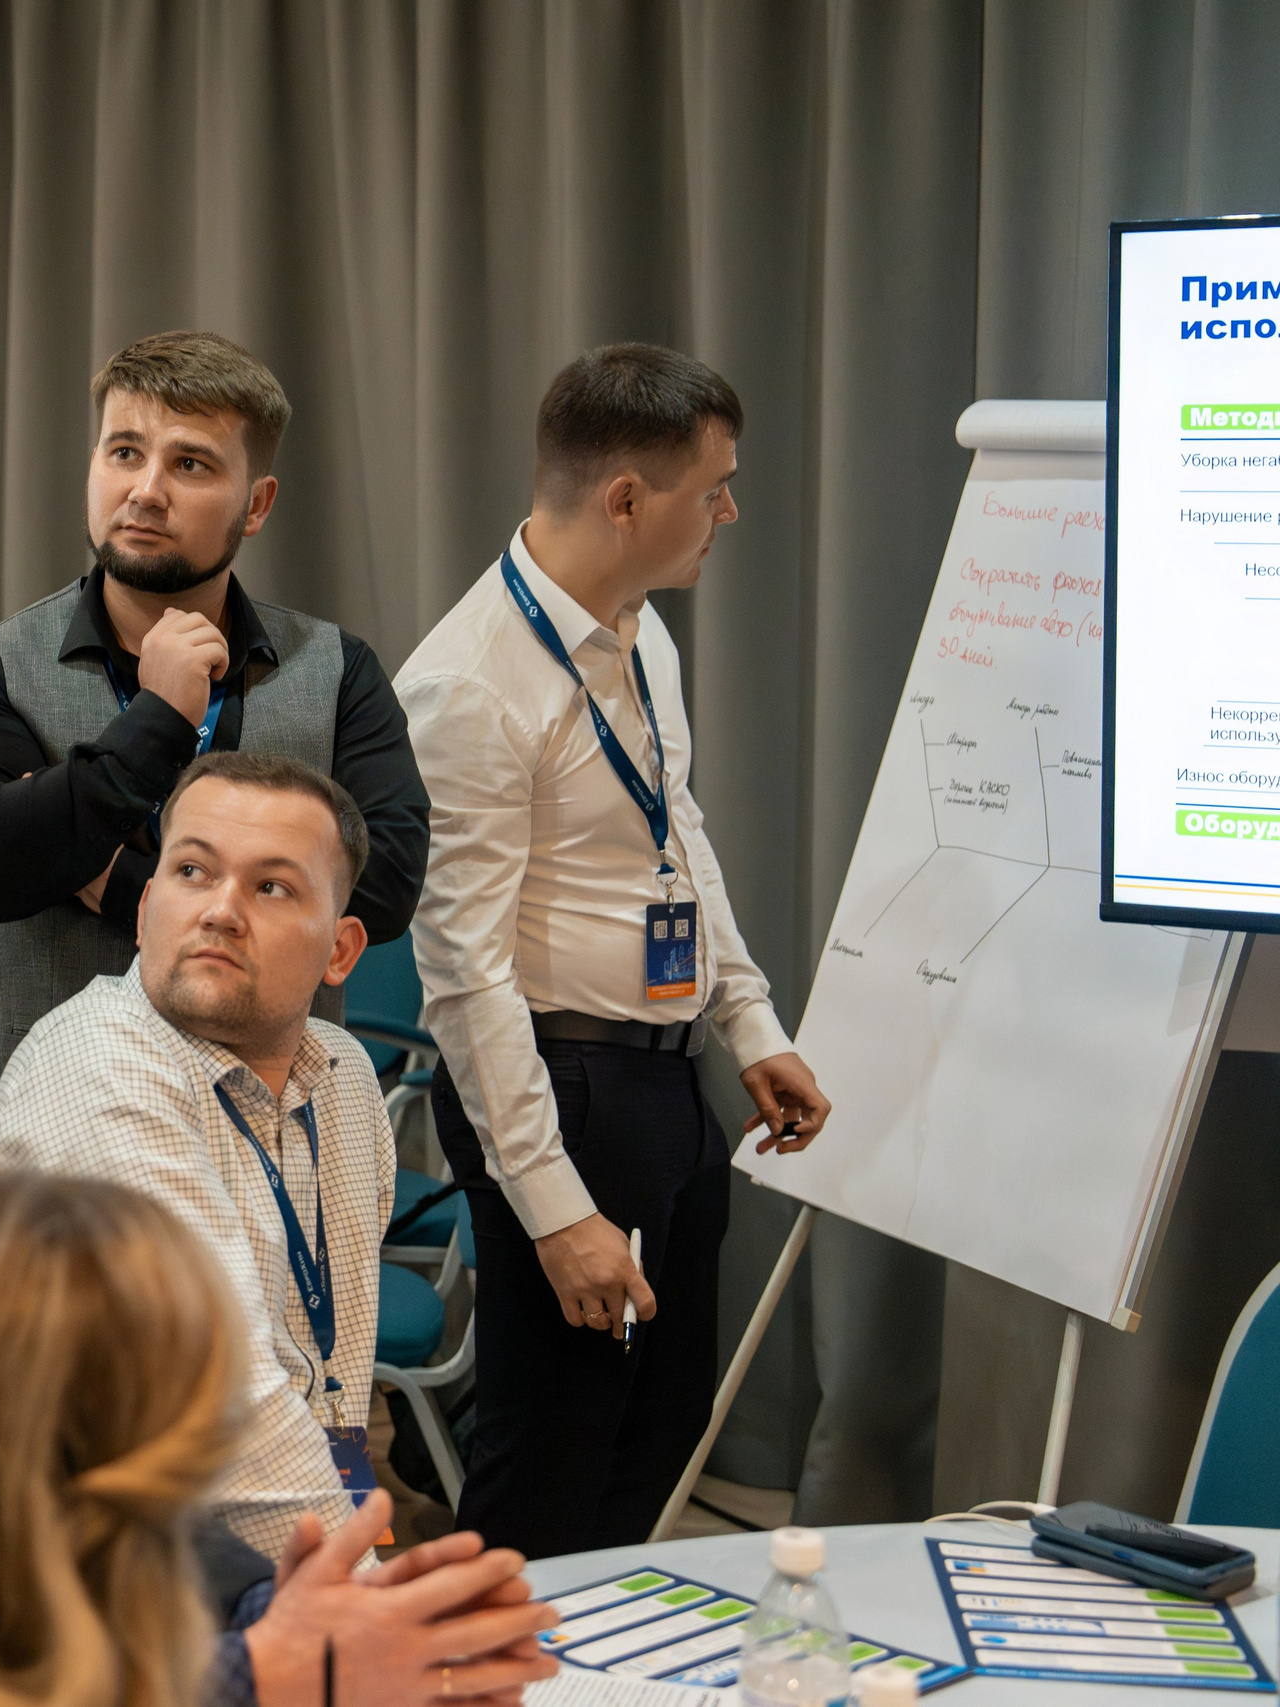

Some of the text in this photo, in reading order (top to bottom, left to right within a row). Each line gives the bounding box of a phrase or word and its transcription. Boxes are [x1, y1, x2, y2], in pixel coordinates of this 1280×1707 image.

[1181, 319, 1280, 340] испо
[1190, 408, 1280, 430] Метод
[1181, 453, 1280, 469] Уборка нега
[1180, 508, 1272, 526] Нарушение
[1211, 706, 1280, 724] Некорре
[1177, 768, 1224, 783] Износ
[978, 779, 1010, 796] КАСКО
